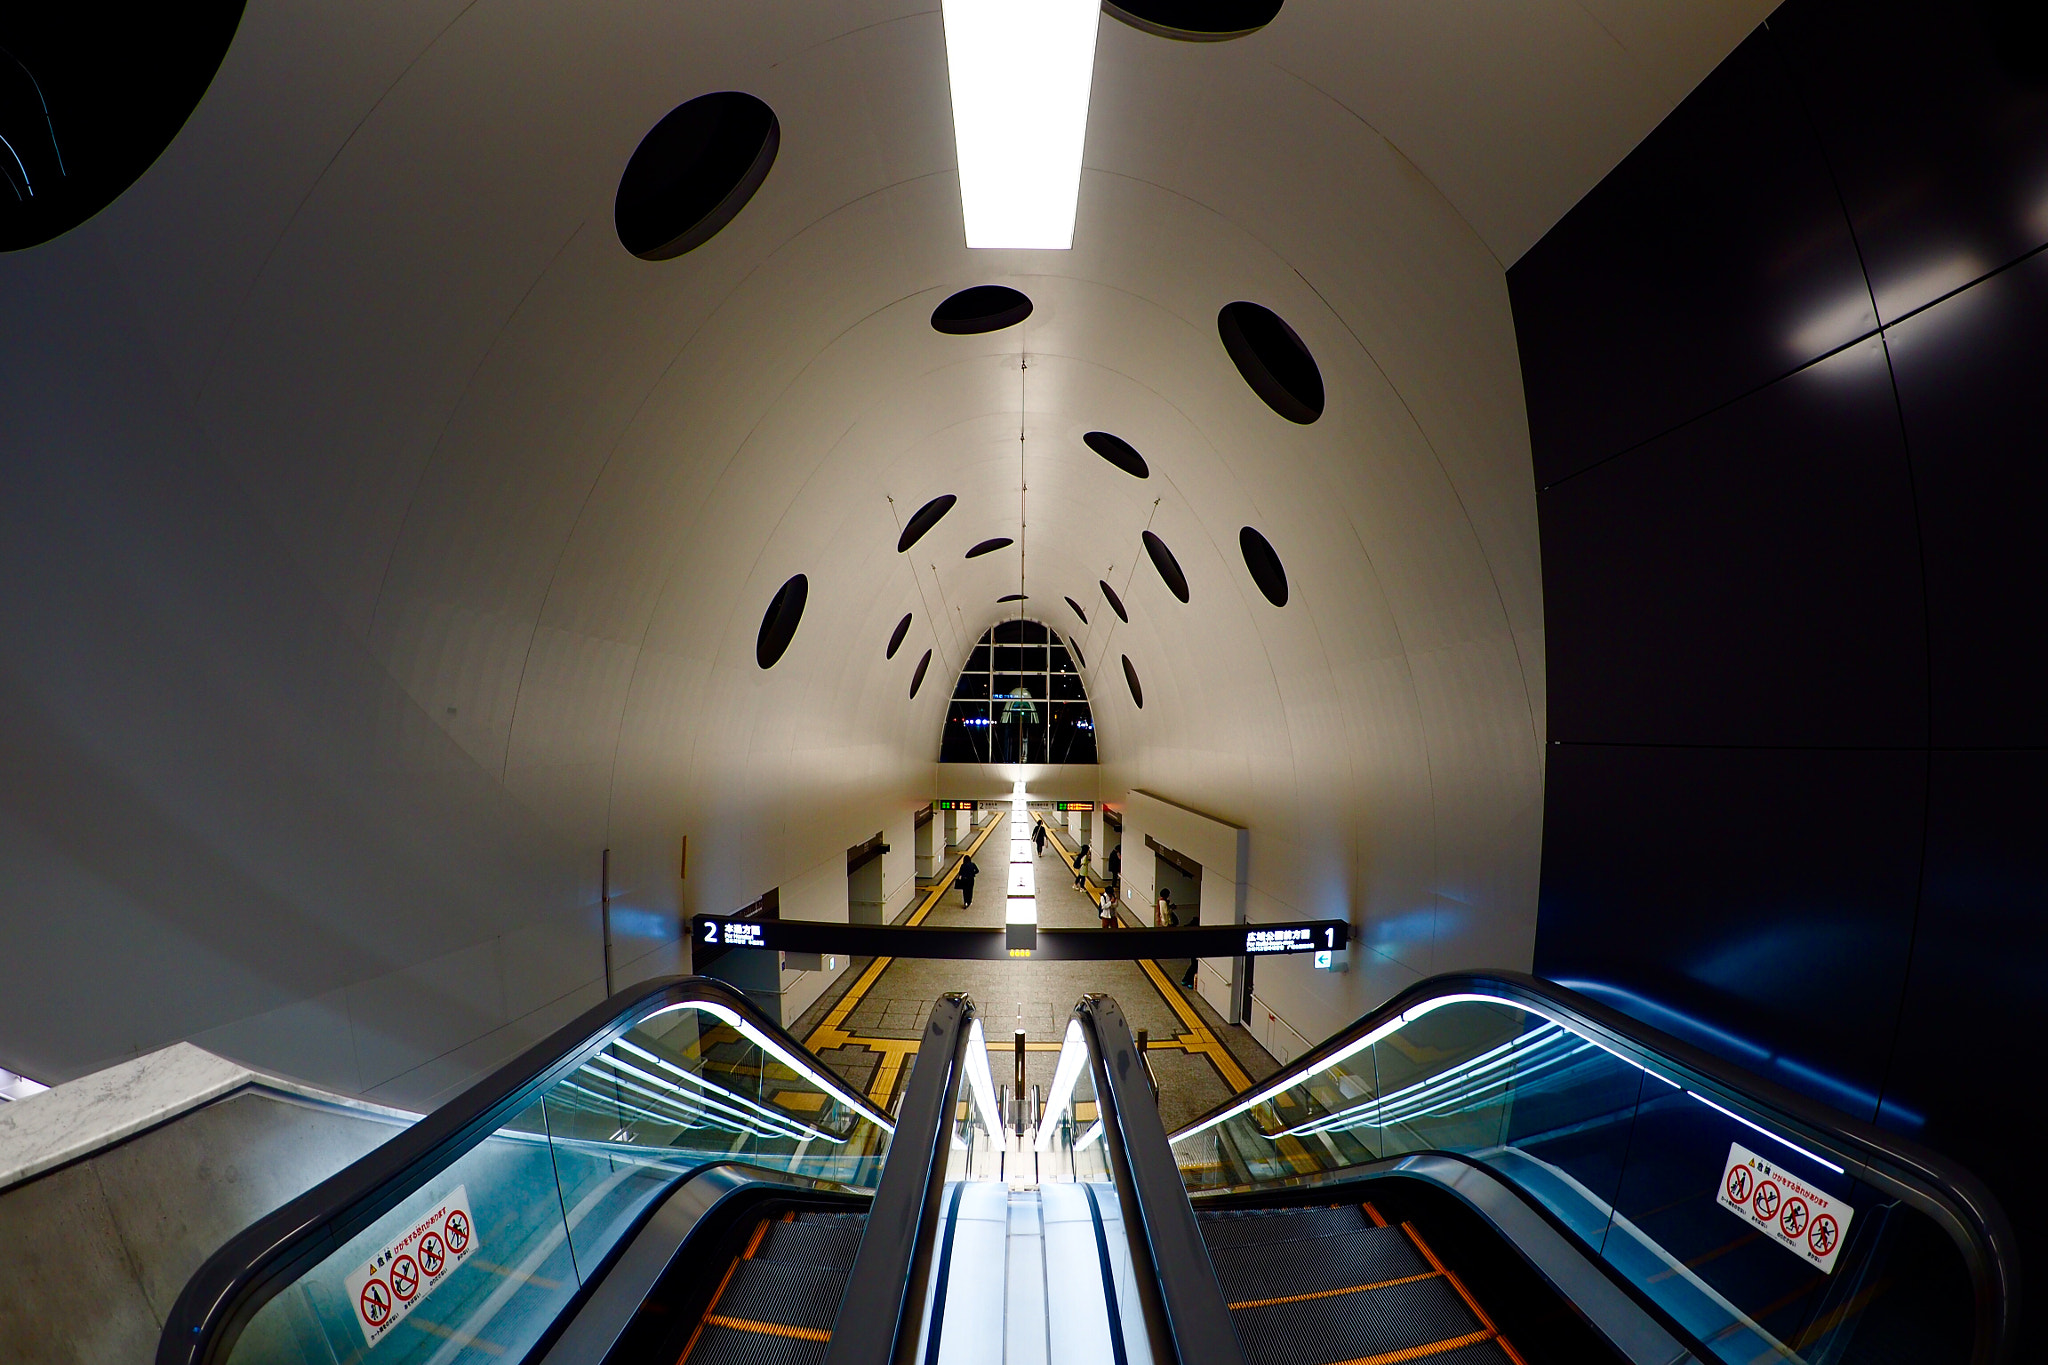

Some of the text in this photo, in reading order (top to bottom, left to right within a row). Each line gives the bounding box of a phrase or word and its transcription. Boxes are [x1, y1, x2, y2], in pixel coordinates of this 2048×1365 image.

[704, 922, 717, 942] 2
[724, 923, 760, 935] 本通方面
[1247, 929, 1310, 941] 広域公園前方面
[1325, 927, 1334, 948] 1
[1757, 1162, 1771, 1176] 危険
[377, 1250, 392, 1268] 危険
